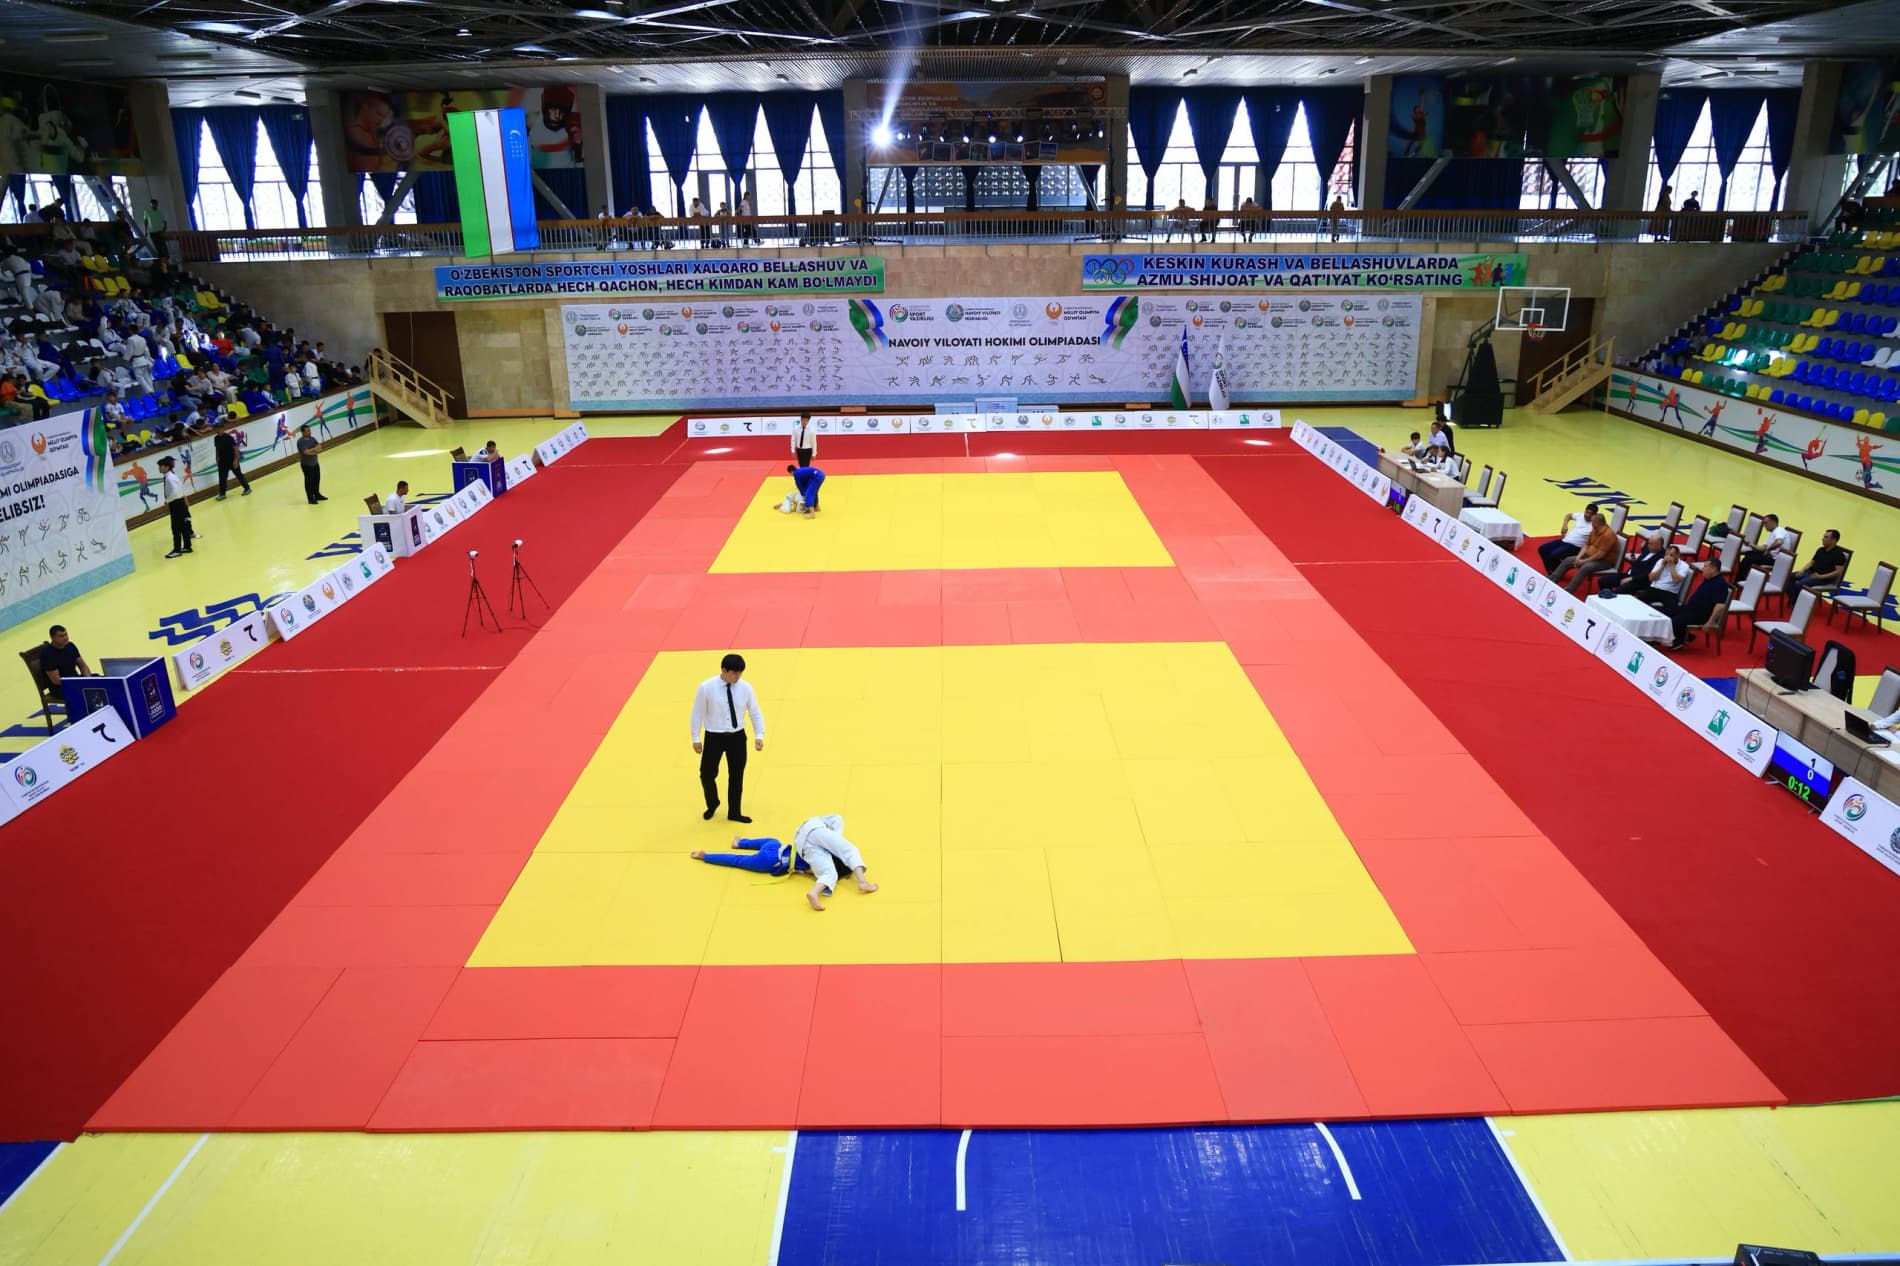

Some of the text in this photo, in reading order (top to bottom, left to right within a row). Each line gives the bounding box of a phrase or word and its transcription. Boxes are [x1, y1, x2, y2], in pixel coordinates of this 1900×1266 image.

[451, 259, 868, 281] O'ZBEKISTON SPORTCHI YOSHLARI XALQARO BELLASHUV VA
[1143, 257, 1458, 270] KESKIN KURASH VA BELLASHUVLARDA
[444, 282, 551, 297] RAQOBATLARDA
[557, 281, 595, 293] HECH
[599, 279, 663, 294] QACHON,
[667, 278, 704, 291] HECH
[709, 277, 763, 290] KIMDAN
[767, 276, 798, 289] KAM
[1137, 274, 1184, 286] AZMU
[1189, 274, 1259, 286] SHIJOAT
[1263, 274, 1284, 286] VA
[888, 336, 1100, 348] NAVOIY VILOYATI HOKIMI OLIMPIADASI
[12, 466, 80, 495] OLIMPIADASIGA
[1811, 758, 1816, 769] 1
[1807, 769, 1815, 780] 0
[1788, 775, 1810, 800] 0:12
